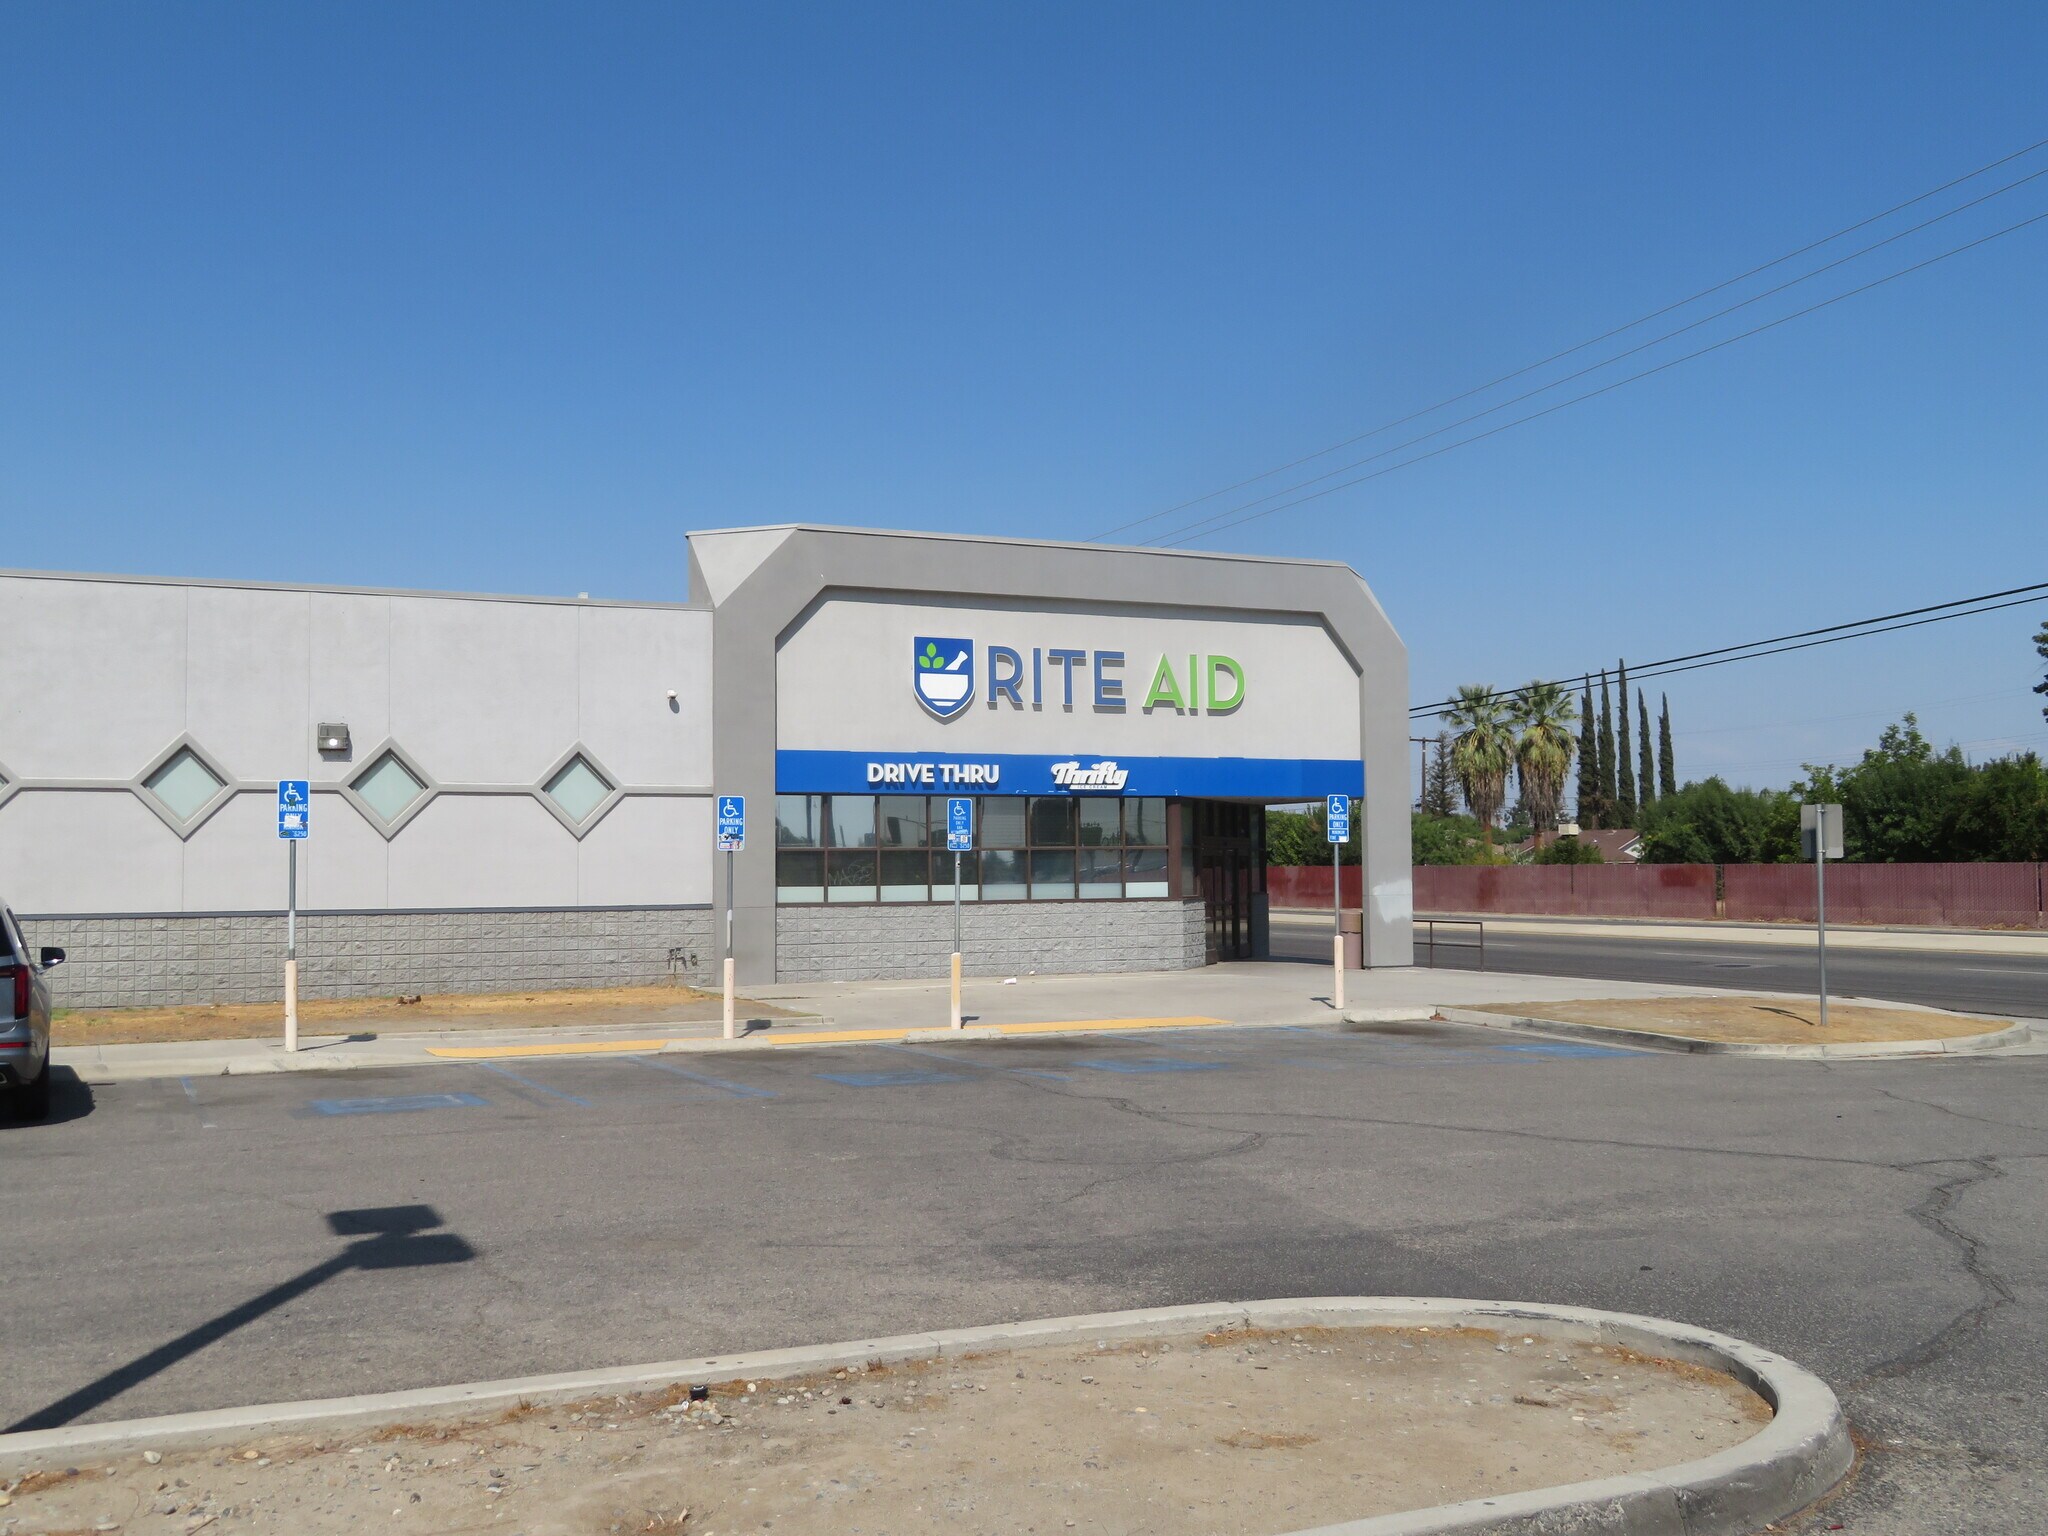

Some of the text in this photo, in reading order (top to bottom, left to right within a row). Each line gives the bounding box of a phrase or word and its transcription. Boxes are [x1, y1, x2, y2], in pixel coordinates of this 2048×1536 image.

[987, 645, 1246, 709] RITE AID
[867, 763, 1000, 783] DRIVE THRU
[1051, 761, 1129, 789] Thrifty
[719, 817, 743, 826] PARKING
[723, 826, 739, 834] ONLY
